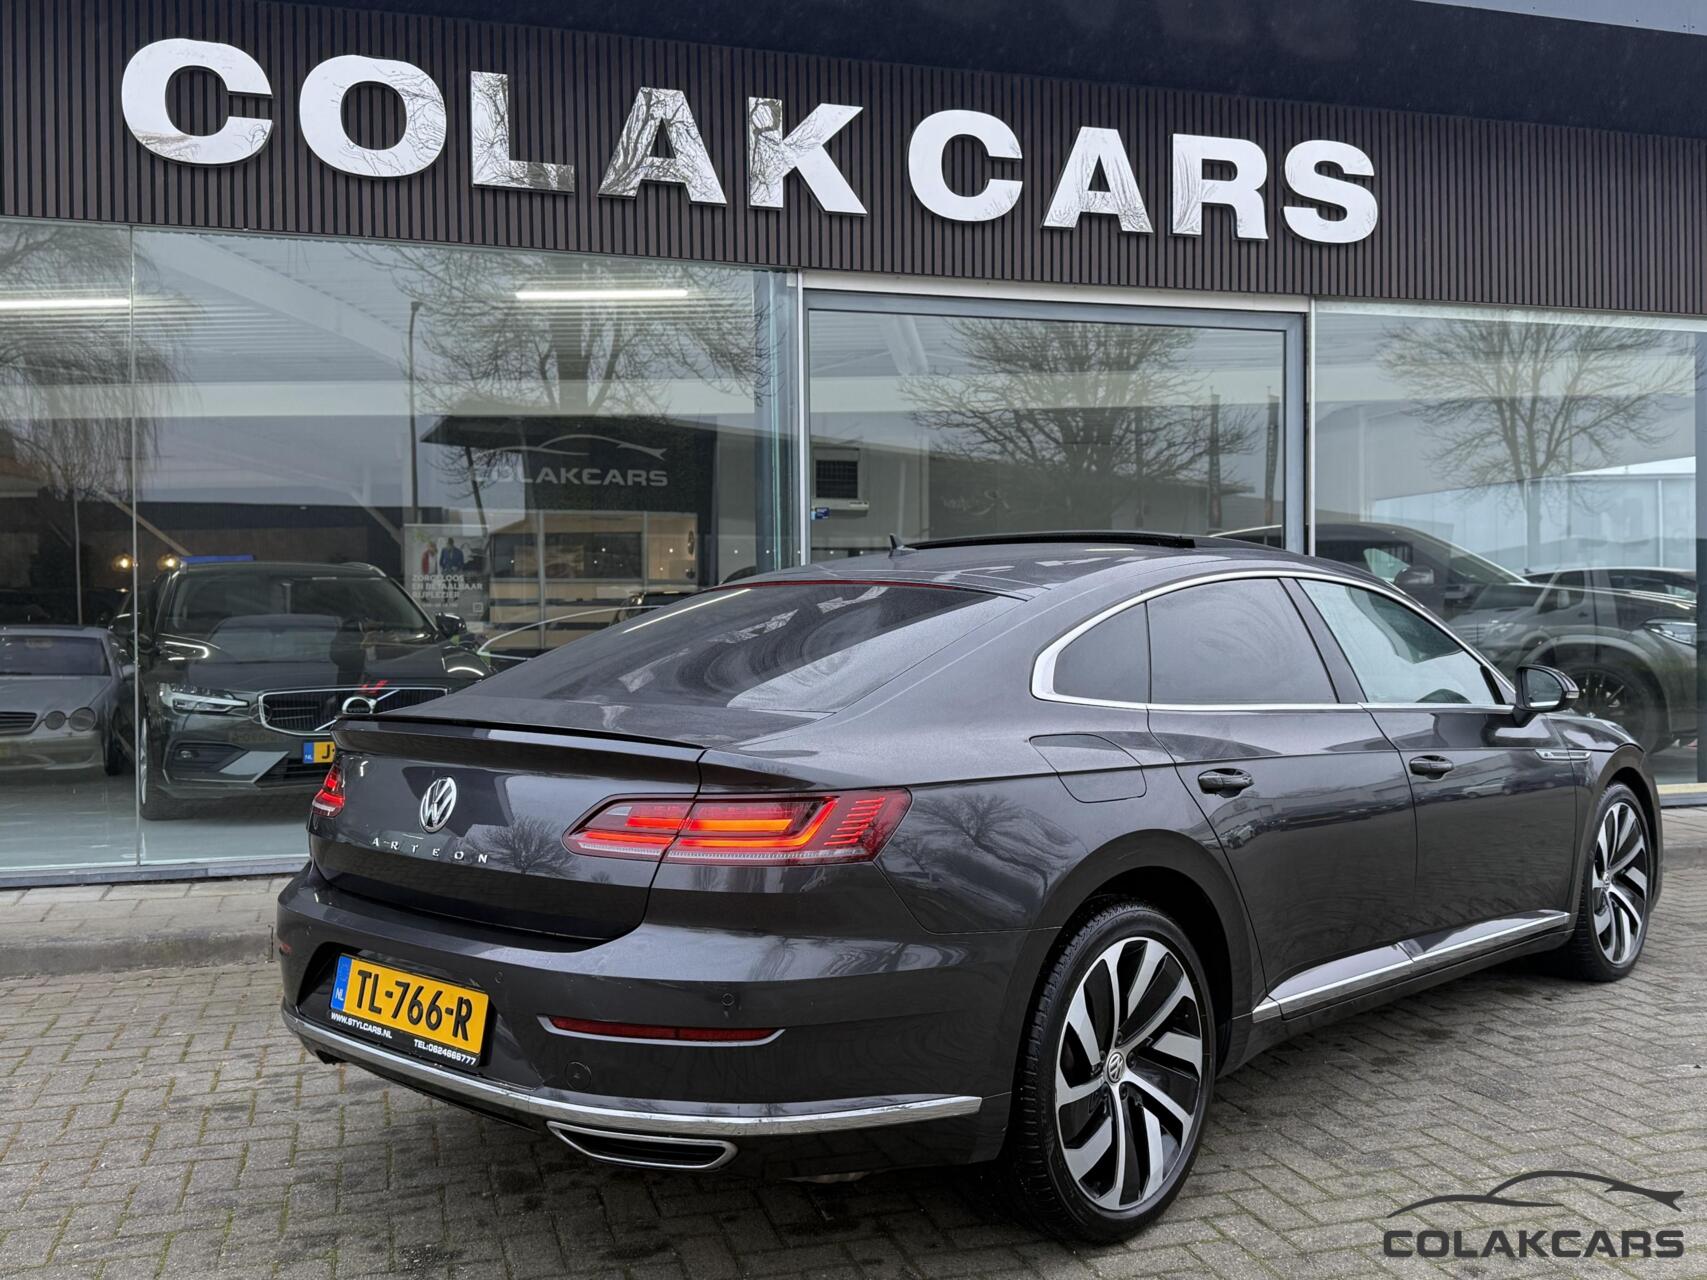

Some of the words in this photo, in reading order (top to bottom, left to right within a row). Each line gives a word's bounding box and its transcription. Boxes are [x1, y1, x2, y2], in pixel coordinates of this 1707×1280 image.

[121, 37, 868, 218] COLAK
[907, 108, 1380, 245] CARS
[371, 836, 488, 864] ARTEON
[334, 987, 345, 1001] NL
[357, 968, 473, 1043] TL-766-R
[330, 1011, 393, 1039] WWW.STYLCARS.NL
